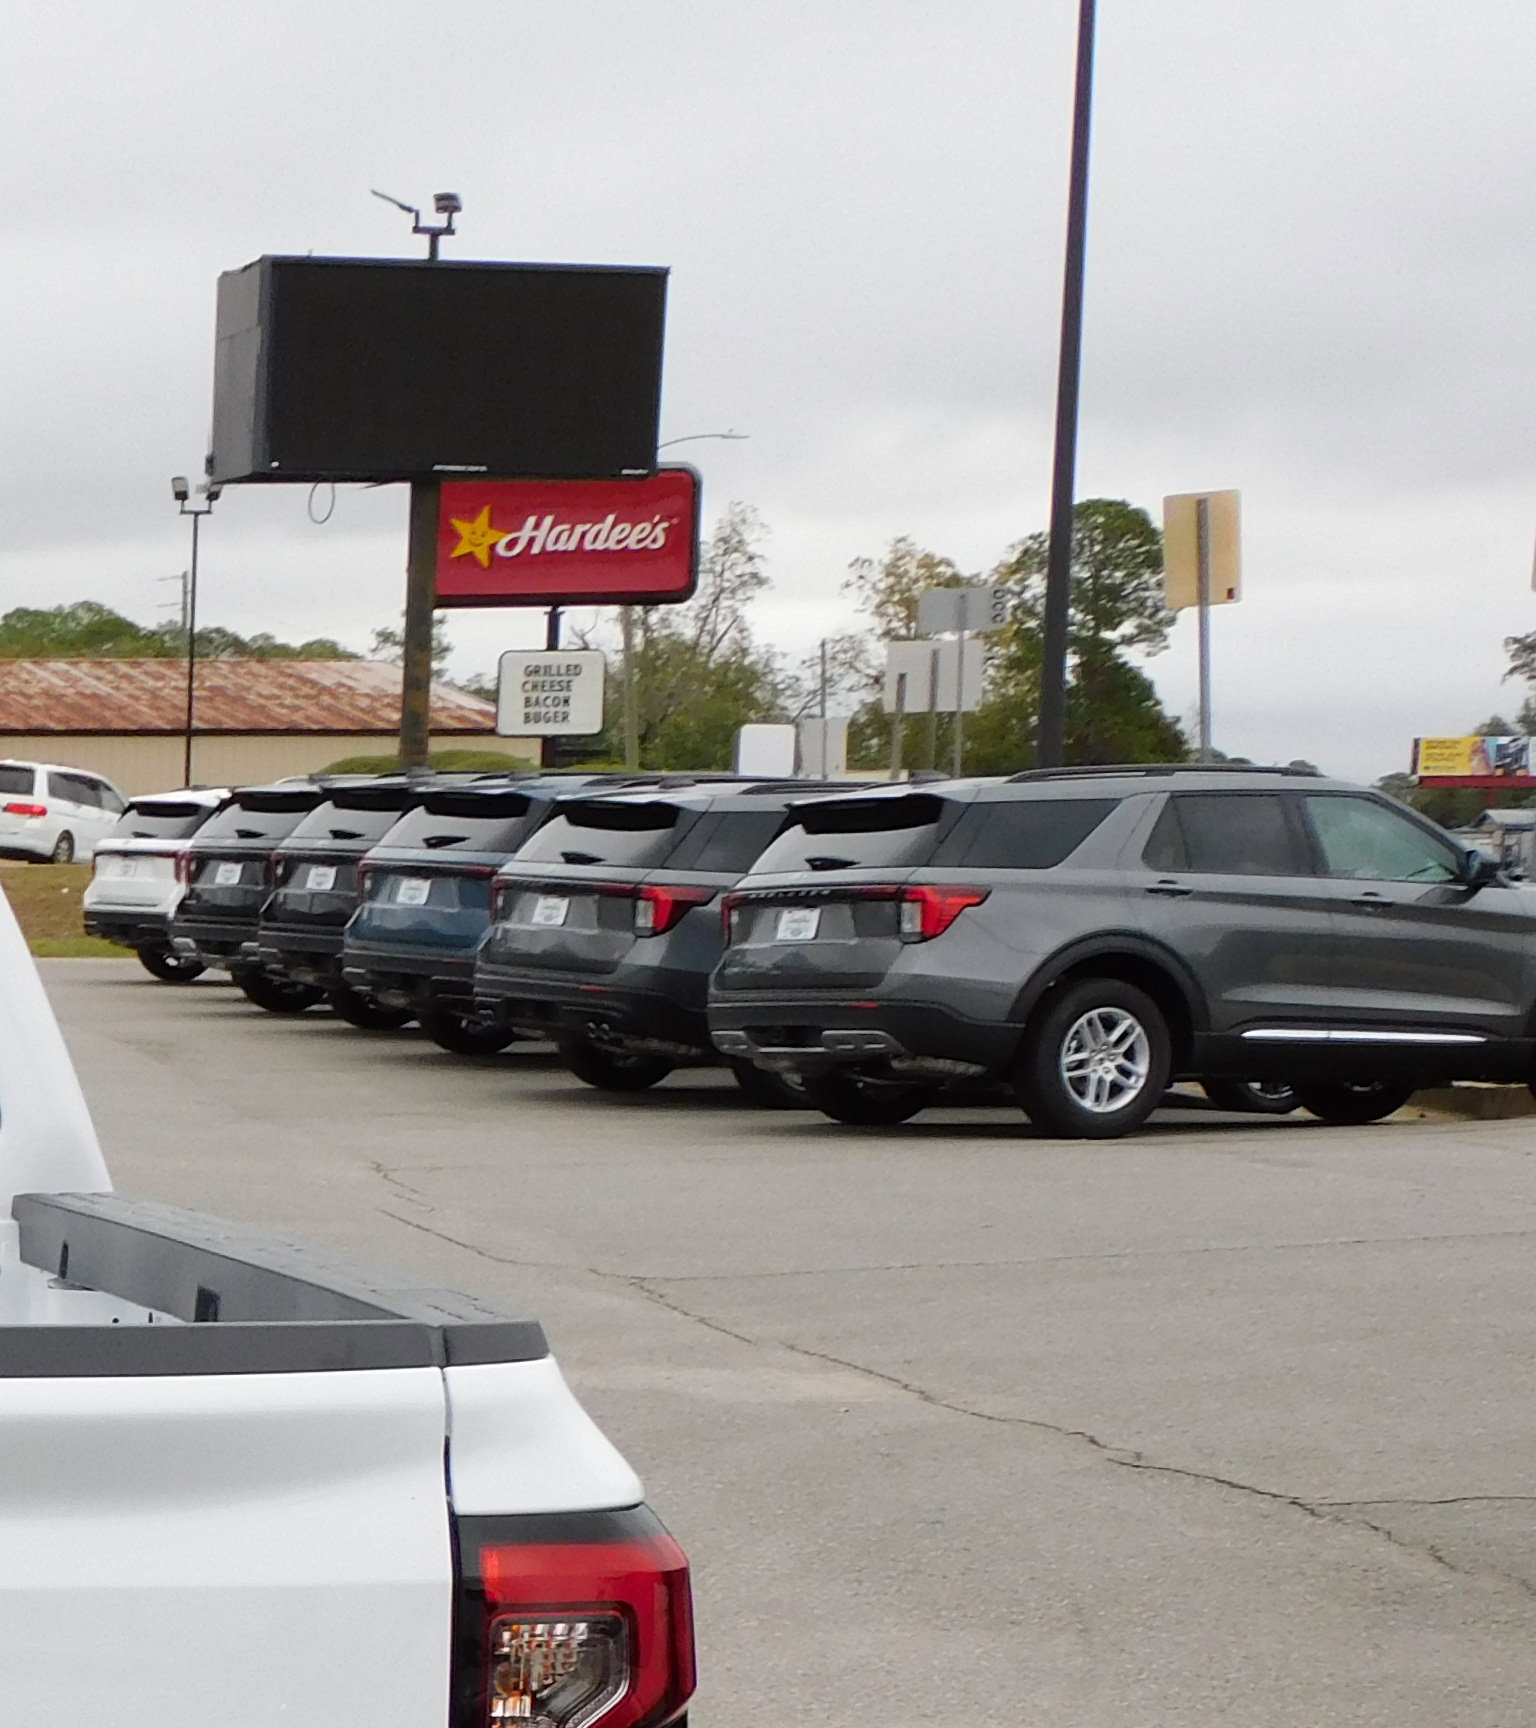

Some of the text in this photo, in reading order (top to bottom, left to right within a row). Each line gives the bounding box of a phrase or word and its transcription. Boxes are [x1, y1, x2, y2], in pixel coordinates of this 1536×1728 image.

[495, 512, 671, 557] Hardee's
[523, 664, 583, 678] GRILLED
[521, 679, 573, 693] CHEESE
[523, 695, 571, 708] BACON
[523, 711, 570, 724] BUGER
